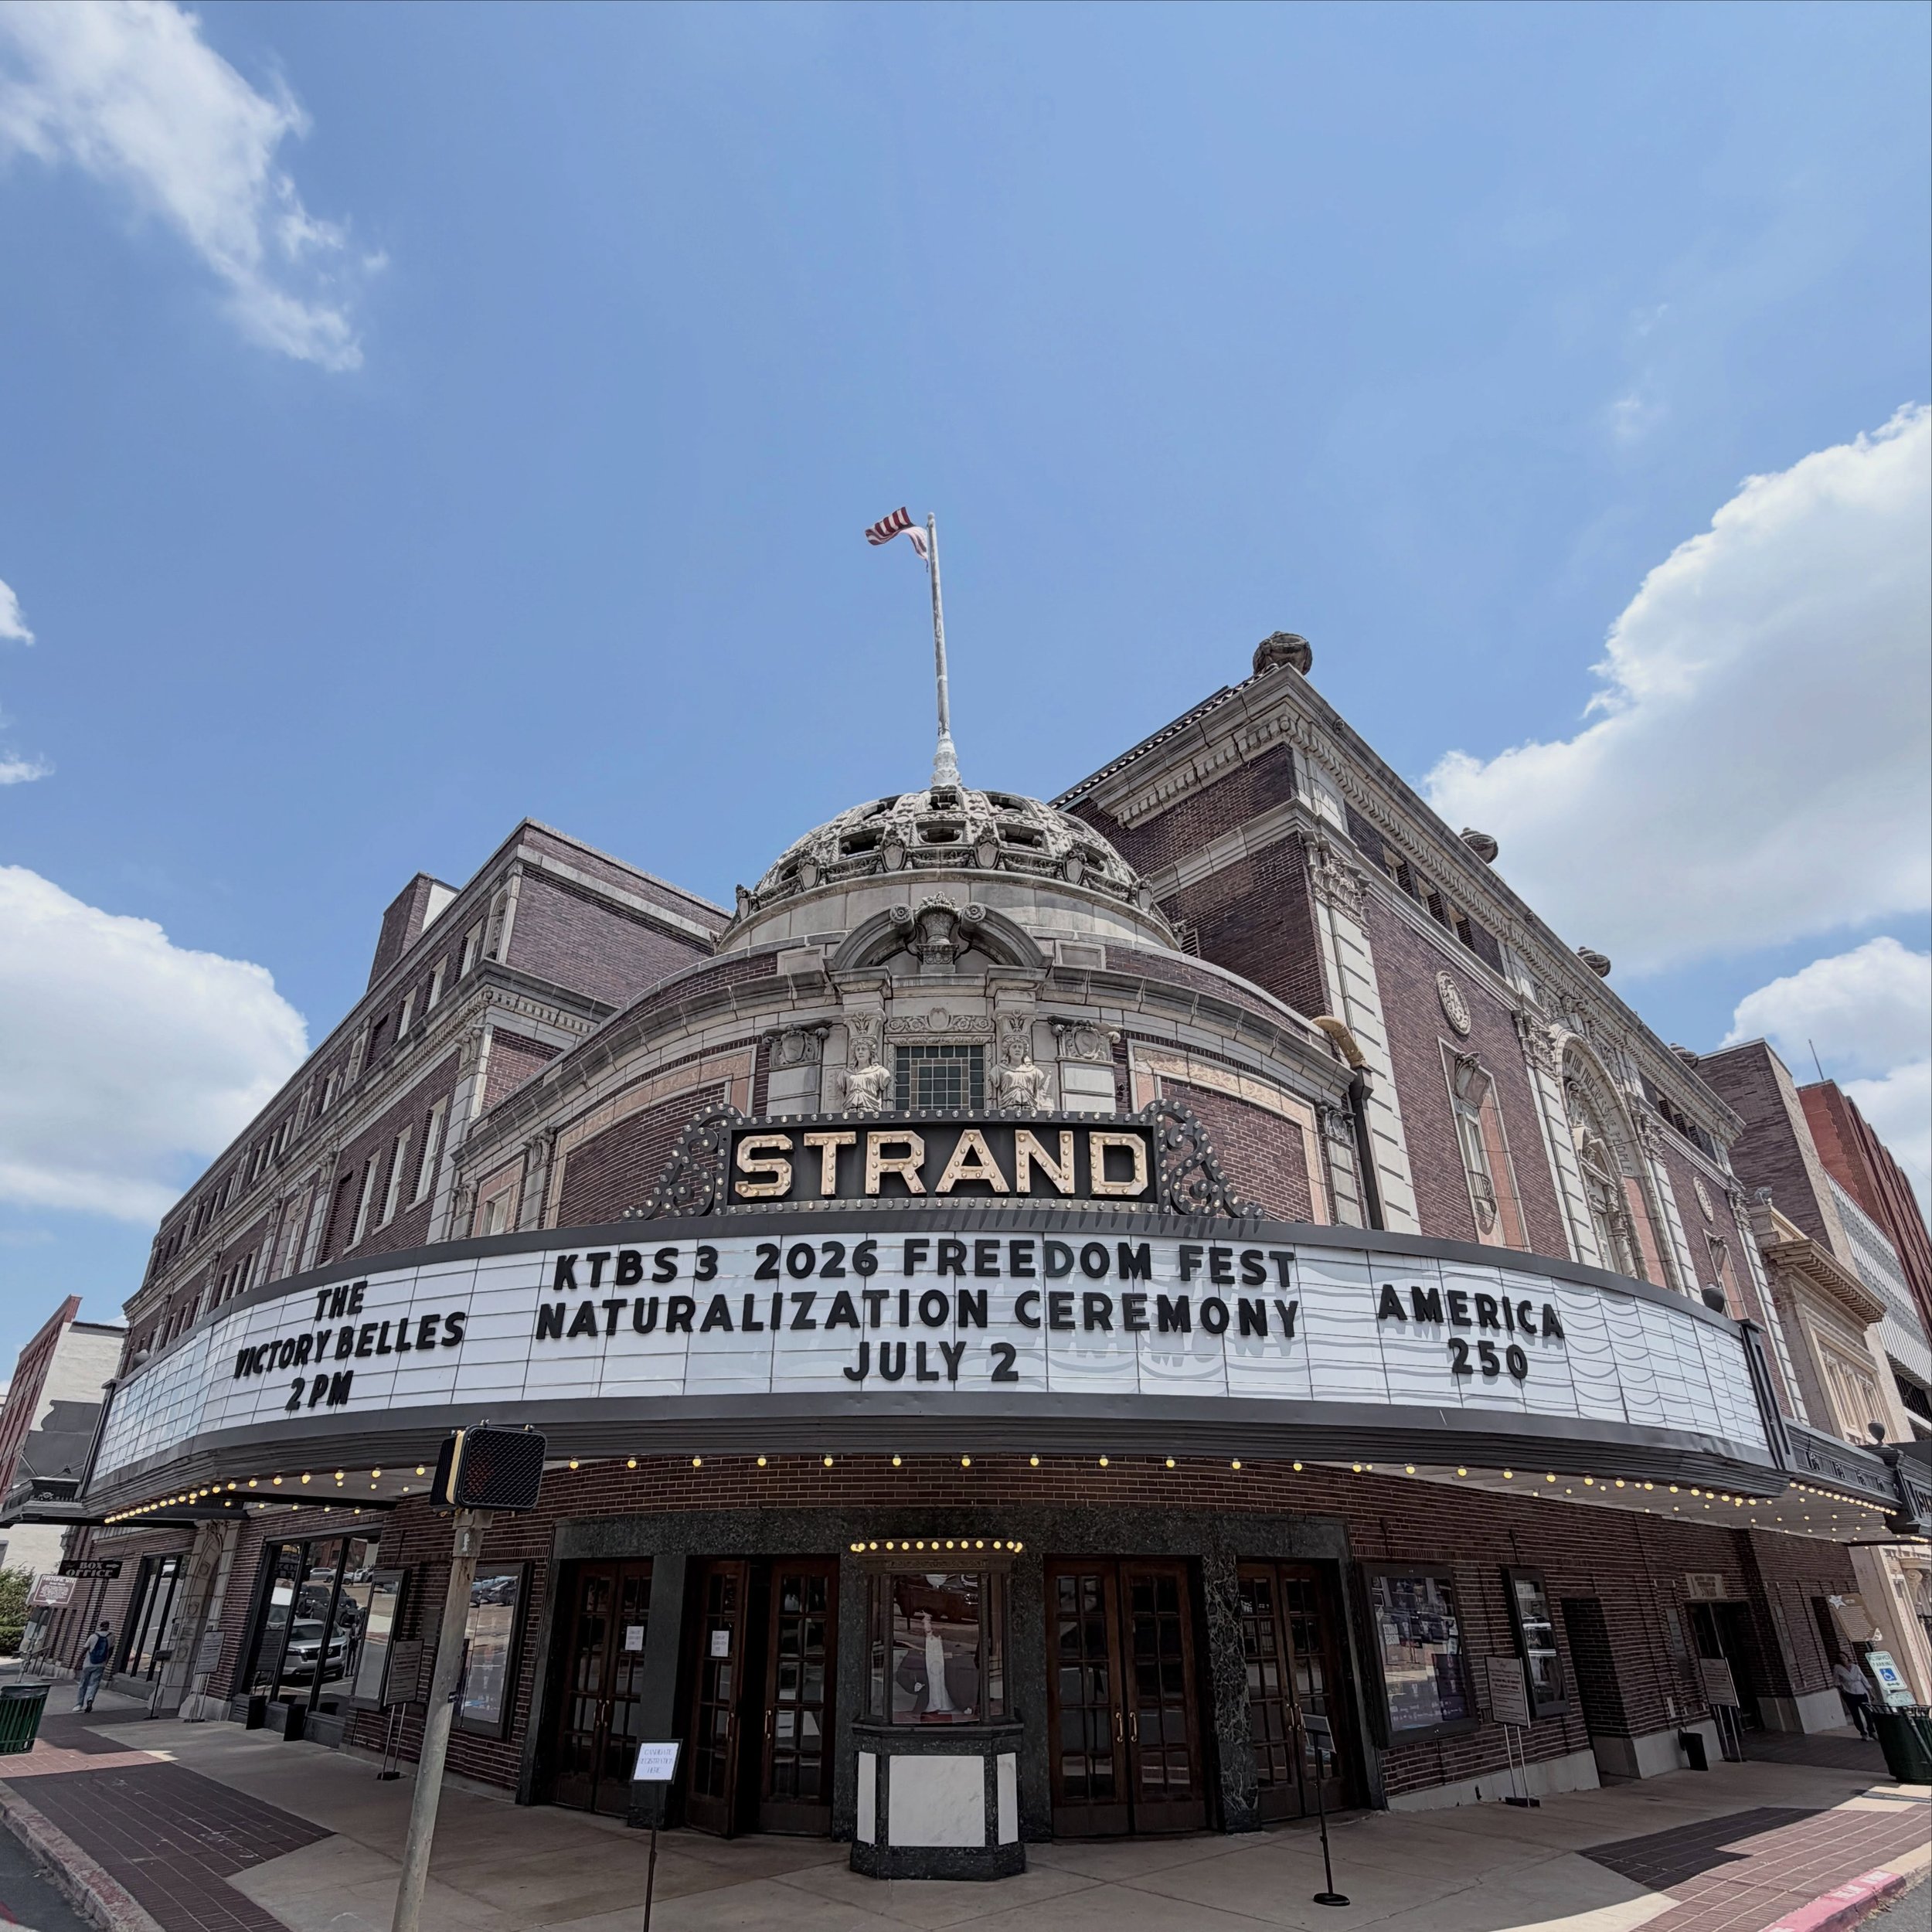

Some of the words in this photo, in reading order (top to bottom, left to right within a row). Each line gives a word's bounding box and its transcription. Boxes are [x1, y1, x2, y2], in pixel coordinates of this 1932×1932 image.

[734, 1128, 1150, 1198] STRAND
[1610, 1132, 1633, 1172] PEOPLE
[754, 1239, 879, 1281] 2026
[903, 1238, 1152, 1280] FREEDOM
[1179, 1244, 1295, 1288] FEST
[314, 1280, 369, 1321] THE
[536, 1288, 988, 1340] NATURALIZATION
[1014, 1290, 1299, 1338] CEREMONY
[1378, 1284, 1565, 1338] AMERICA
[233, 1328, 332, 1379] VICTORY
[334, 1311, 466, 1360] BELLES
[843, 1340, 967, 1382] JULY
[991, 1342, 1019, 1382] 2
[1447, 1337, 1529, 1379] 250
[284, 1377, 306, 1411] 2
[307, 1369, 354, 1409] PM
